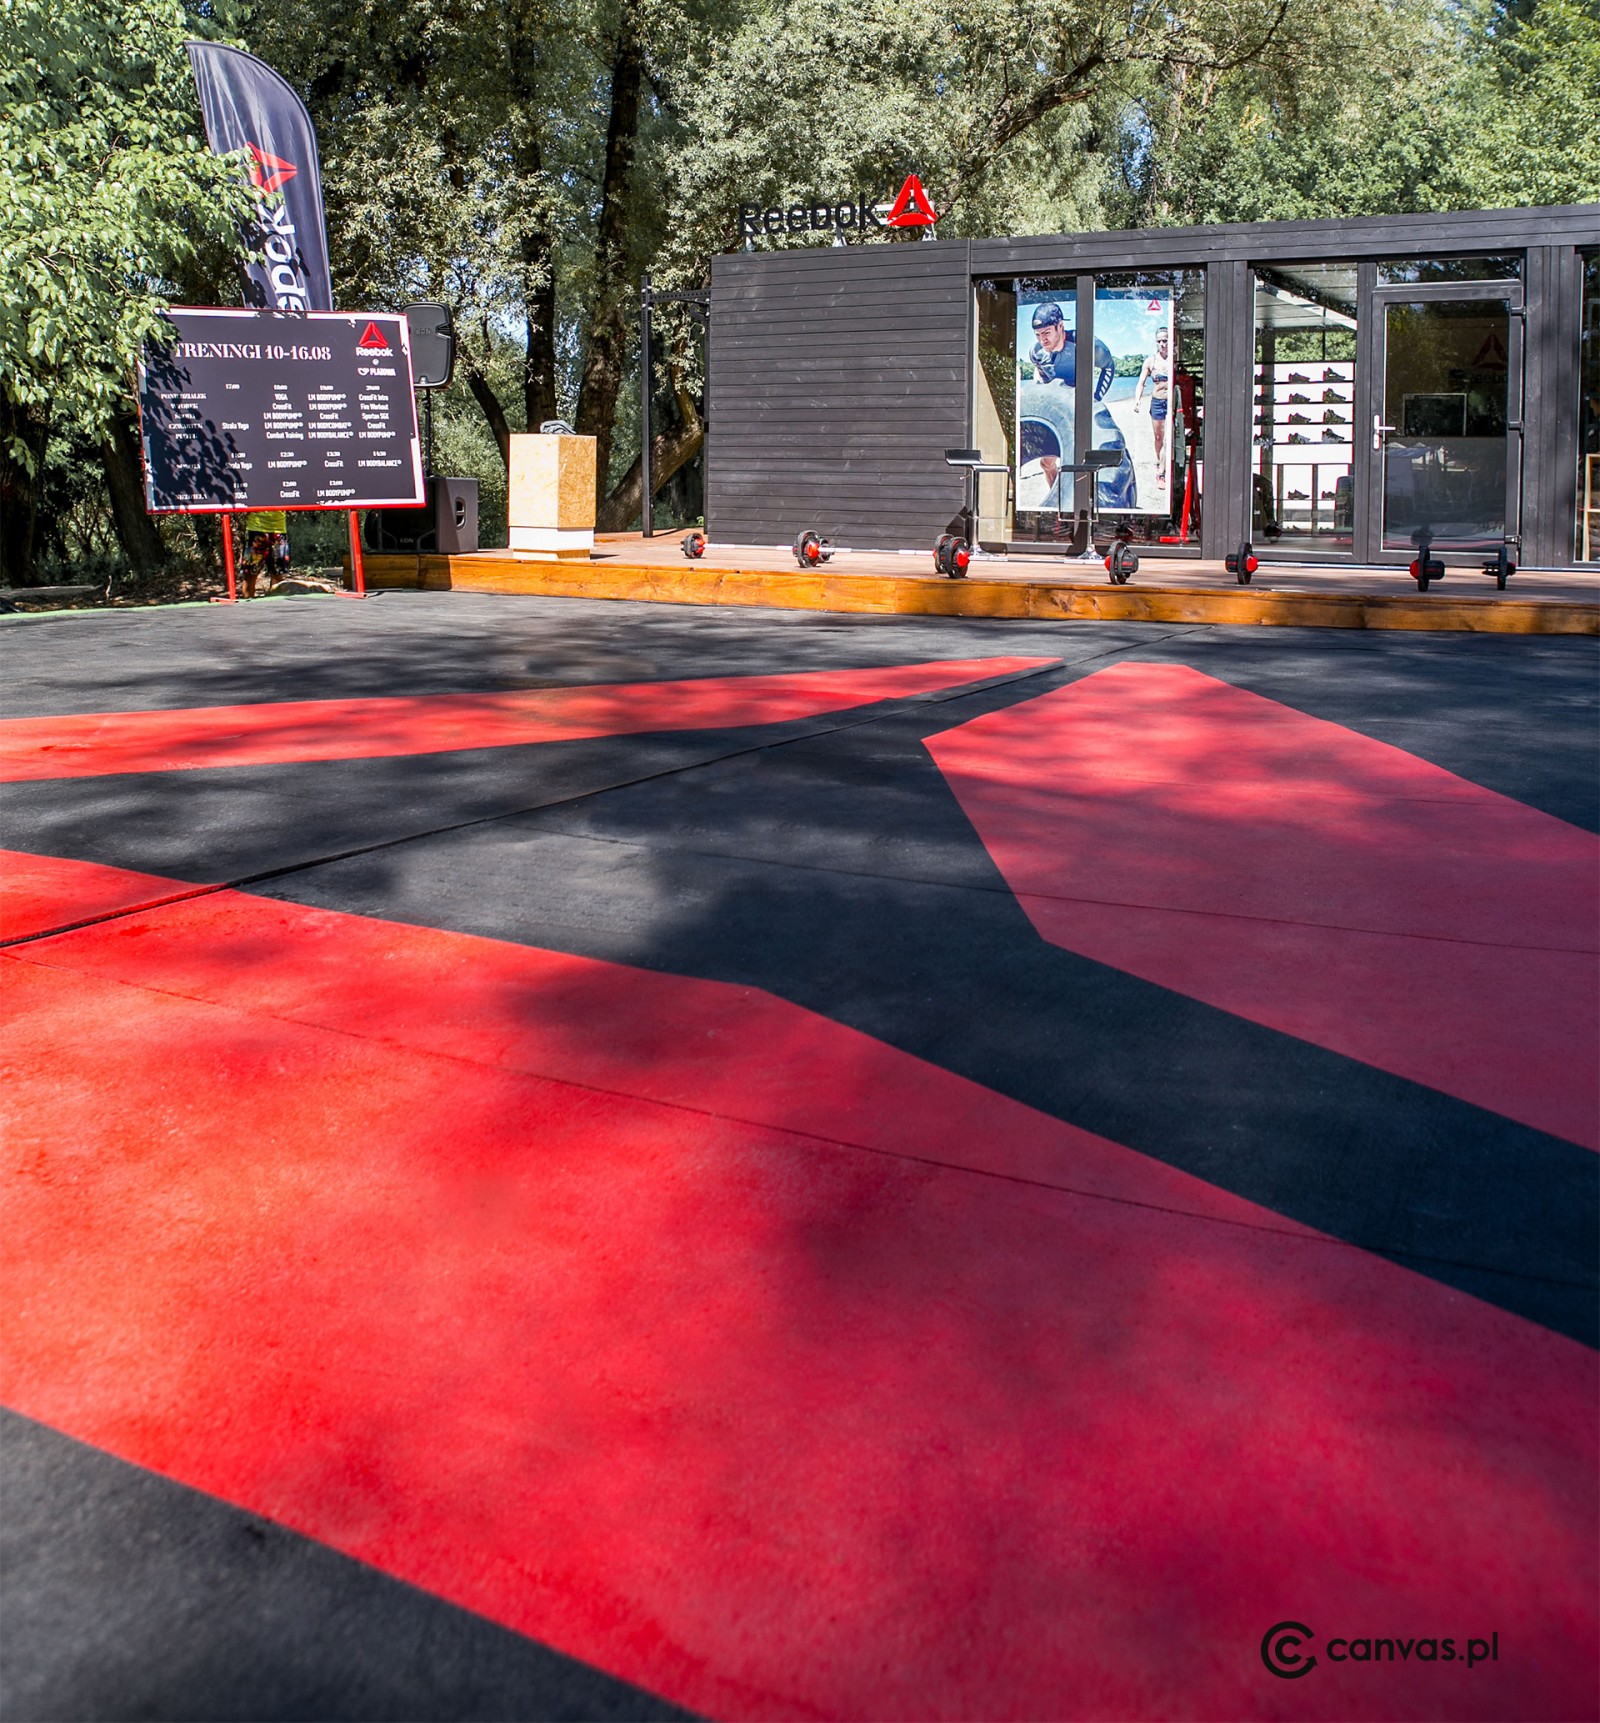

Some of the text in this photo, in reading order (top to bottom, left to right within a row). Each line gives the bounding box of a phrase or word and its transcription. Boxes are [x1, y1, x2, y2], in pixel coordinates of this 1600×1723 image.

[740, 192, 886, 236] Reebok
[175, 342, 331, 360] TRENINGI 10-16.08
[356, 347, 393, 356] Reebok
[275, 392, 288, 400] YOGA
